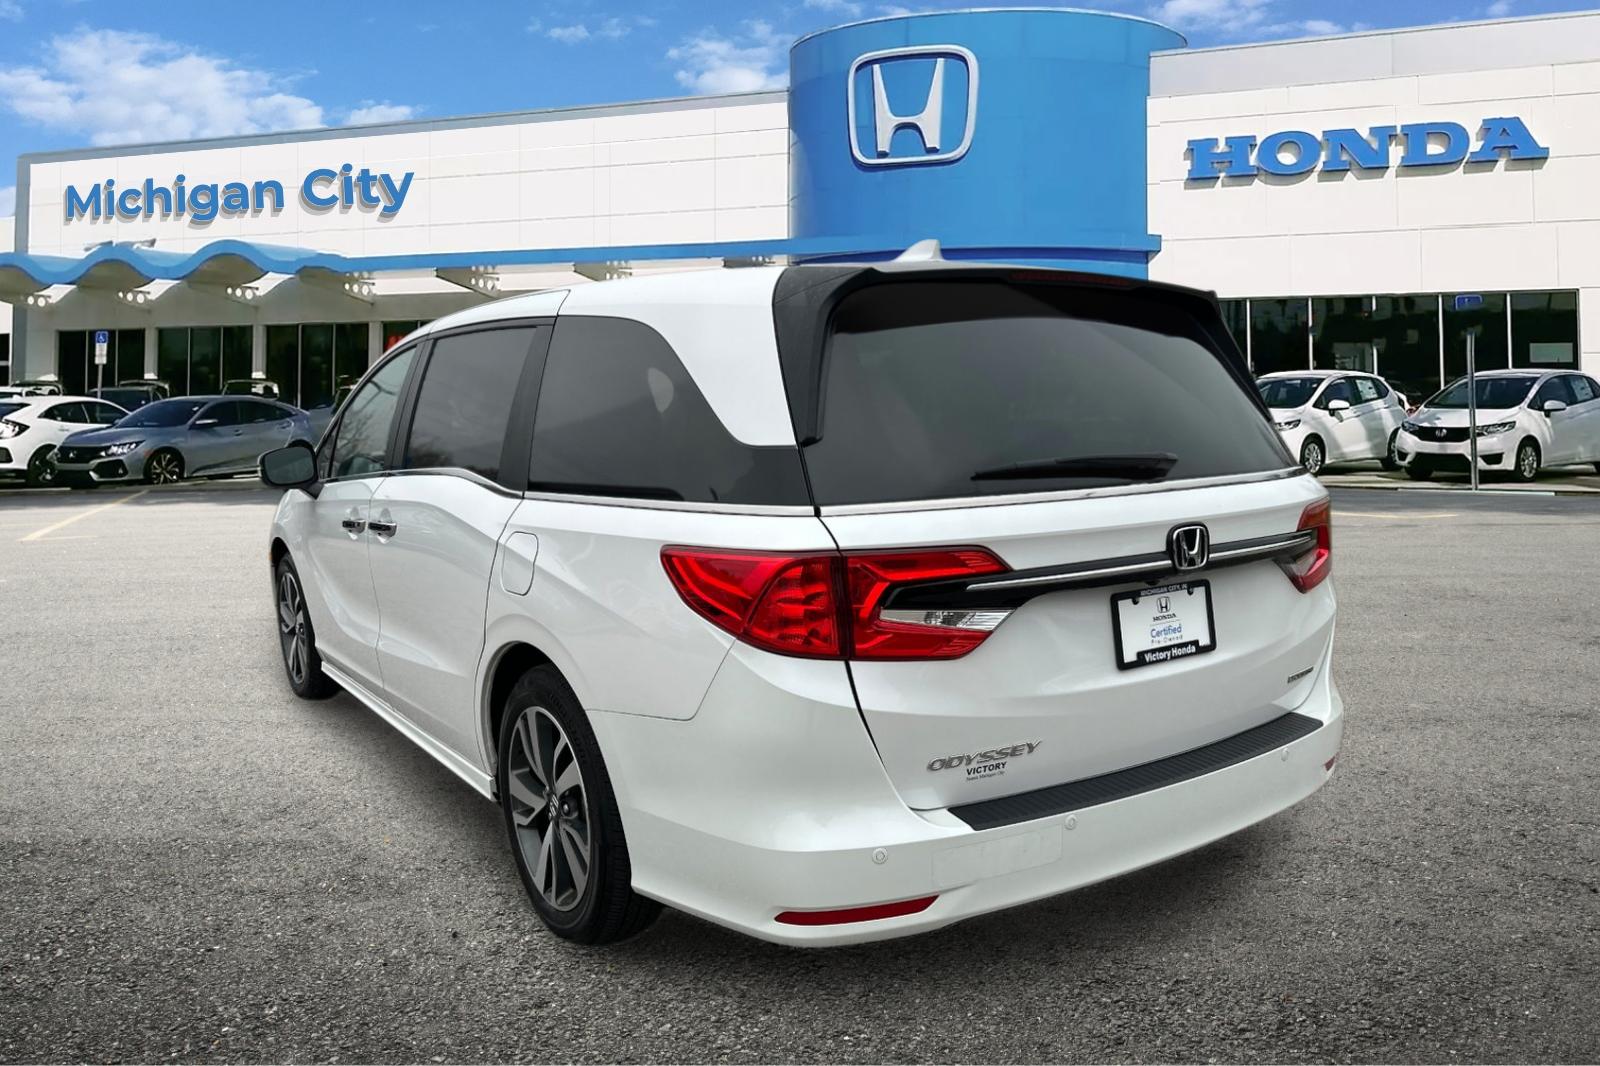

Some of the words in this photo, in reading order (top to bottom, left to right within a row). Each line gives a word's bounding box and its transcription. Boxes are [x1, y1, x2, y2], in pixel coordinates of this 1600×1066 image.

[1186, 116, 1550, 184] HONDA
[65, 174, 285, 221] Michigan
[302, 162, 415, 214] City
[1150, 623, 1182, 638] Certified
[1144, 650, 1170, 663] Victory
[1171, 644, 1196, 657] Honda
[926, 738, 1042, 772] ODYSSEY
[966, 761, 1007, 776] VICTORY
